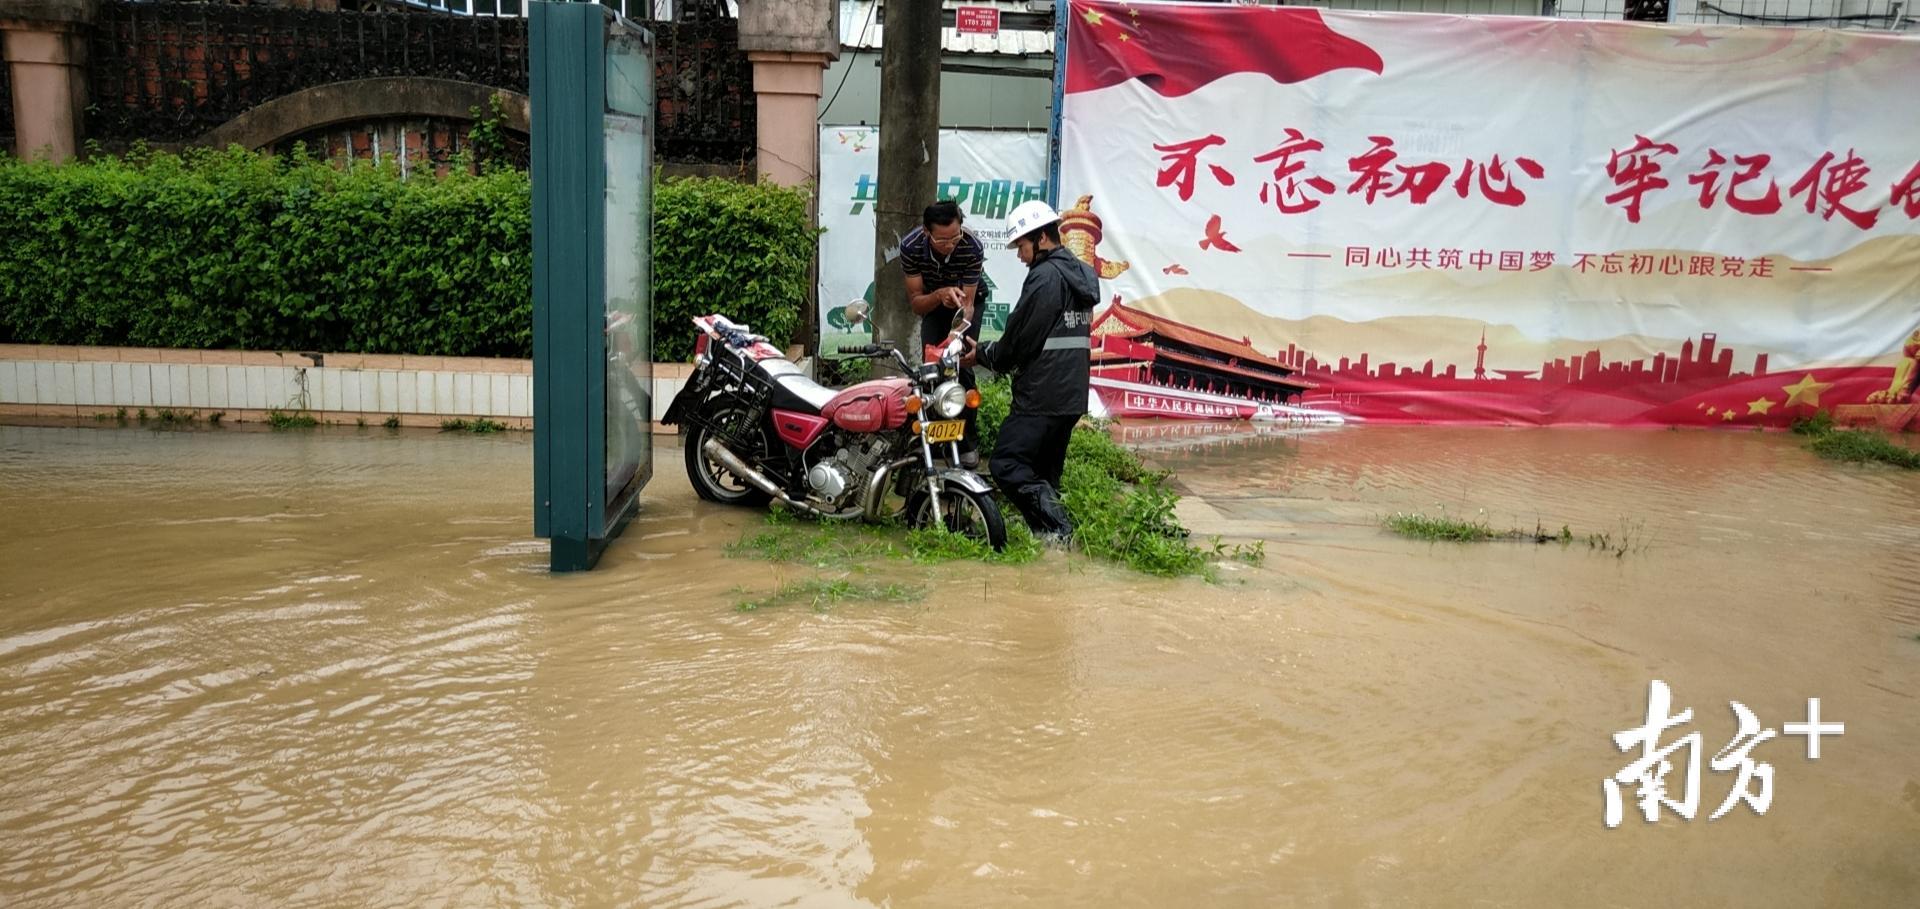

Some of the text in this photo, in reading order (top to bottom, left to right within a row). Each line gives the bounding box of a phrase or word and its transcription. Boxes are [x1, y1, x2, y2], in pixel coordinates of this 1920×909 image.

[1153, 127, 1545, 214] 不忘初心
[1345, 246, 1775, 278] 同心共筑中国梦 不忘初心跟党走
